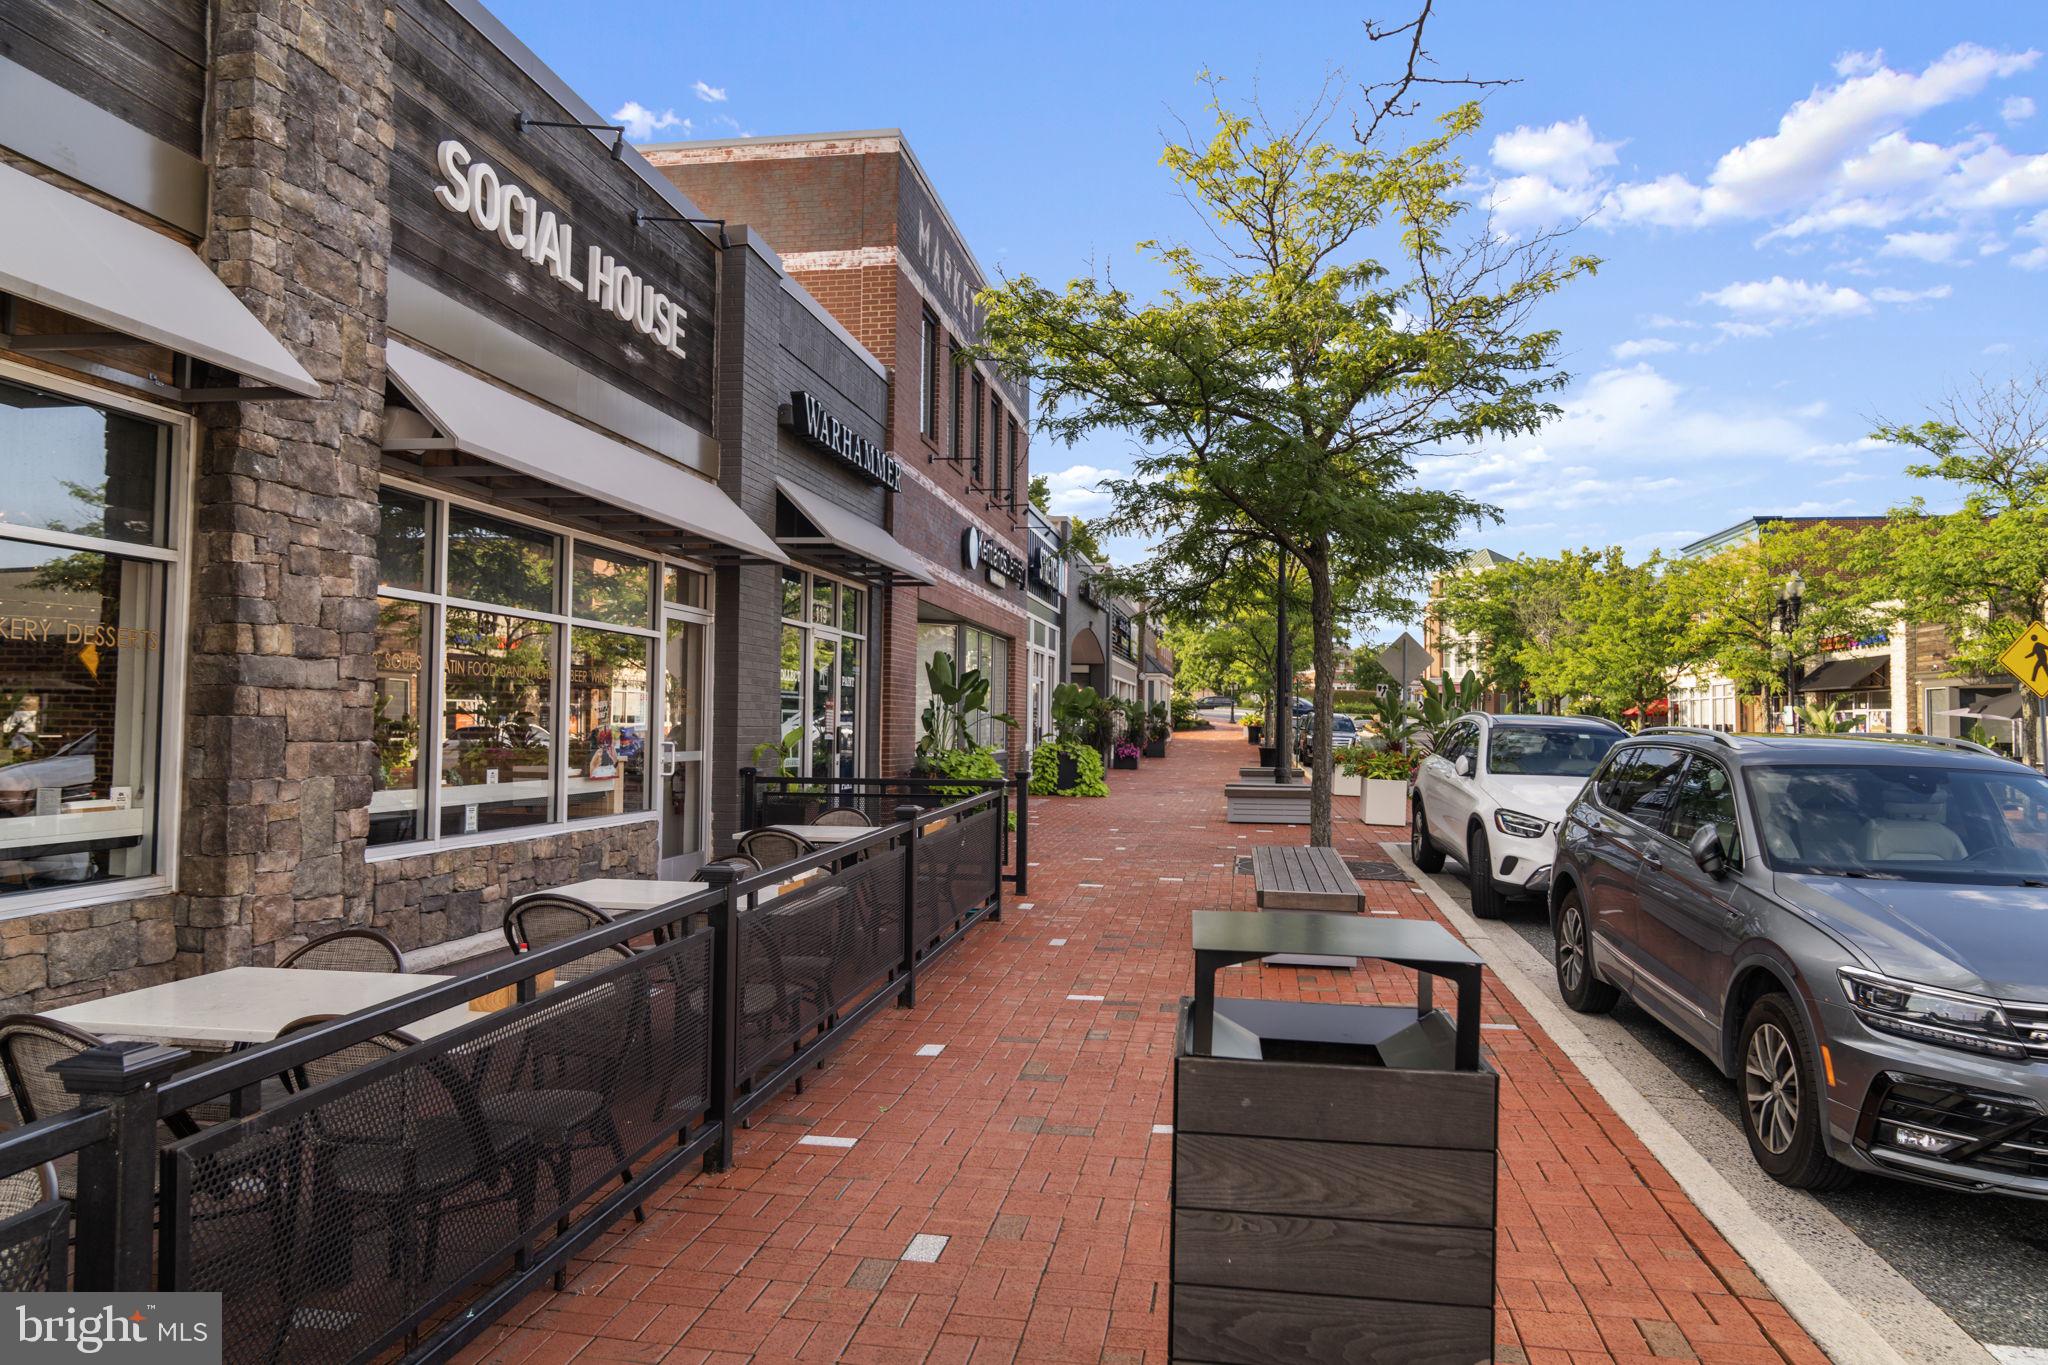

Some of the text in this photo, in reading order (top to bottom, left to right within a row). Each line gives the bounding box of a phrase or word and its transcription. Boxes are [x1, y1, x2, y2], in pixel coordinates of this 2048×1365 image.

[434, 140, 688, 360] SOCIAL HOUSE
[804, 391, 902, 493] WARHAMMER
[66, 623, 159, 650] DESSERTS
[384, 652, 422, 670] SOUPS
[467, 660, 497, 677] FOOD
[569, 669, 588, 683] BEER
[591, 670, 610, 685] WINE
